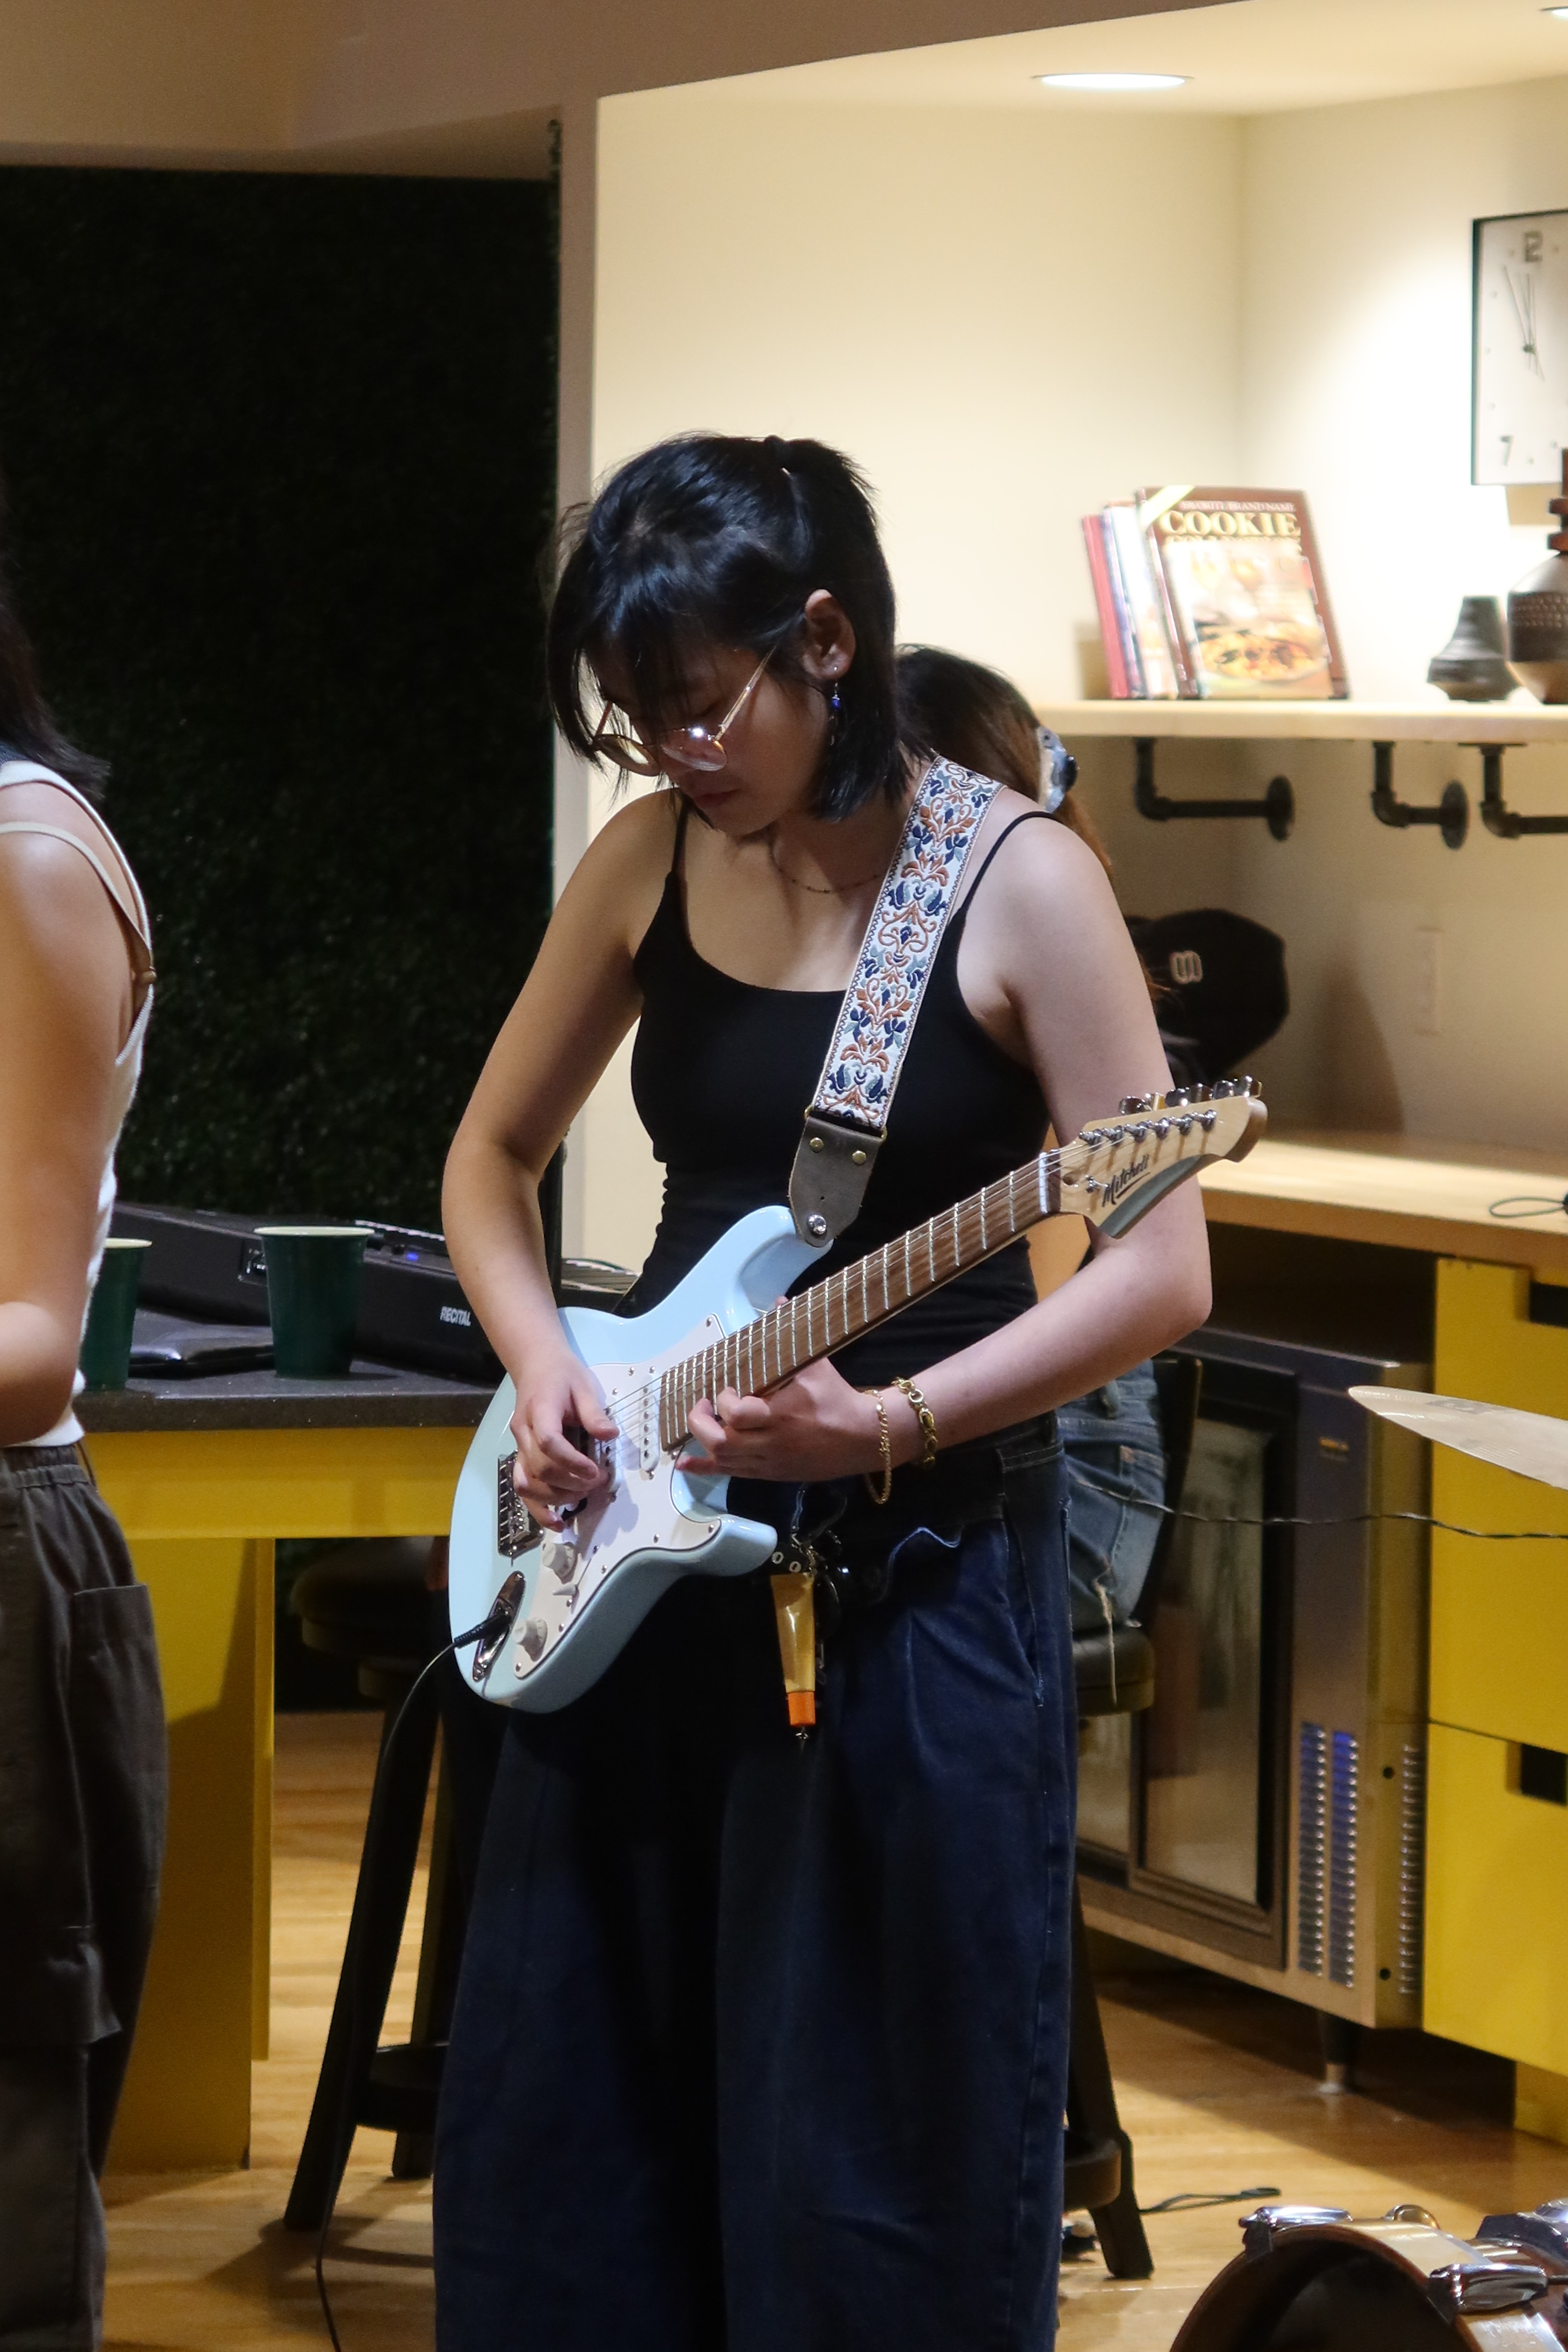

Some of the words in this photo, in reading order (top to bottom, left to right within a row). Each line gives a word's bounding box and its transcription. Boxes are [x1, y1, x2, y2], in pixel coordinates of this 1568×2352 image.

[1500, 434, 1514, 467] 7
[1160, 510, 1301, 536] COOKIE
[1102, 1154, 1149, 1207] Mitchell
[440, 1306, 471, 1327] RECITAL
